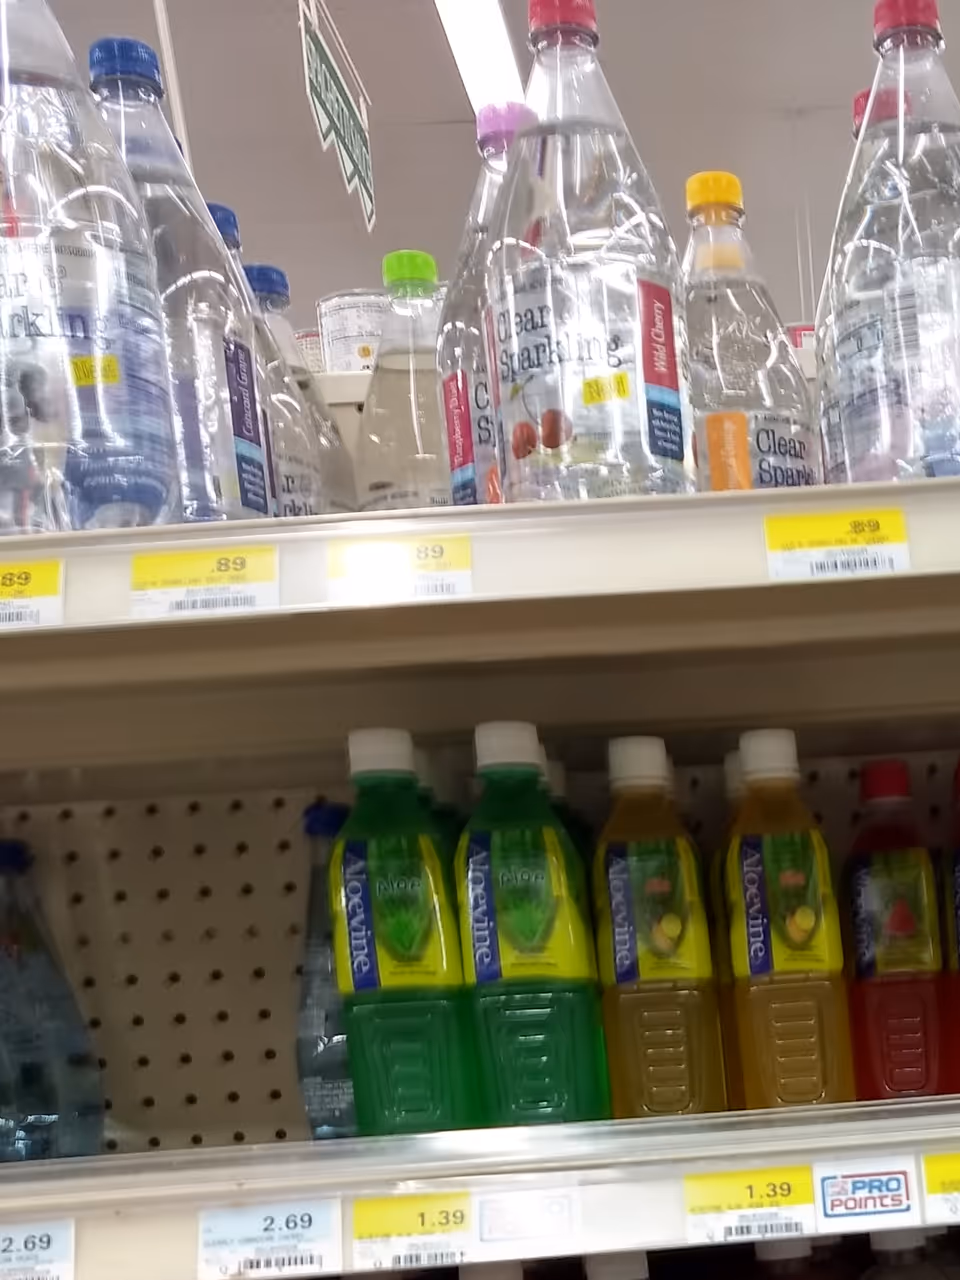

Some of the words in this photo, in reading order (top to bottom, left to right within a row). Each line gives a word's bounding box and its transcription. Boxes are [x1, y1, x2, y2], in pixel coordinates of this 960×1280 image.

[649, 299, 666, 341] Cherry
[654, 341, 668, 374] Wild
[755, 427, 806, 456] Clear
[210, 555, 248, 574] .89
[345, 850, 372, 975] Aloevine
[467, 848, 494, 965] Aloevine
[608, 856, 634, 968] Aloevine
[742, 847, 768, 965] Aloevine
[744, 1181, 793, 1200] 1.39
[850, 1176, 903, 1196] PRO
[829, 1194, 904, 1212] POINTS
[262, 1212, 314, 1233] 2.69
[416, 1209, 466, 1228] 1.39
[1, 1232, 52, 1254] 2.69
